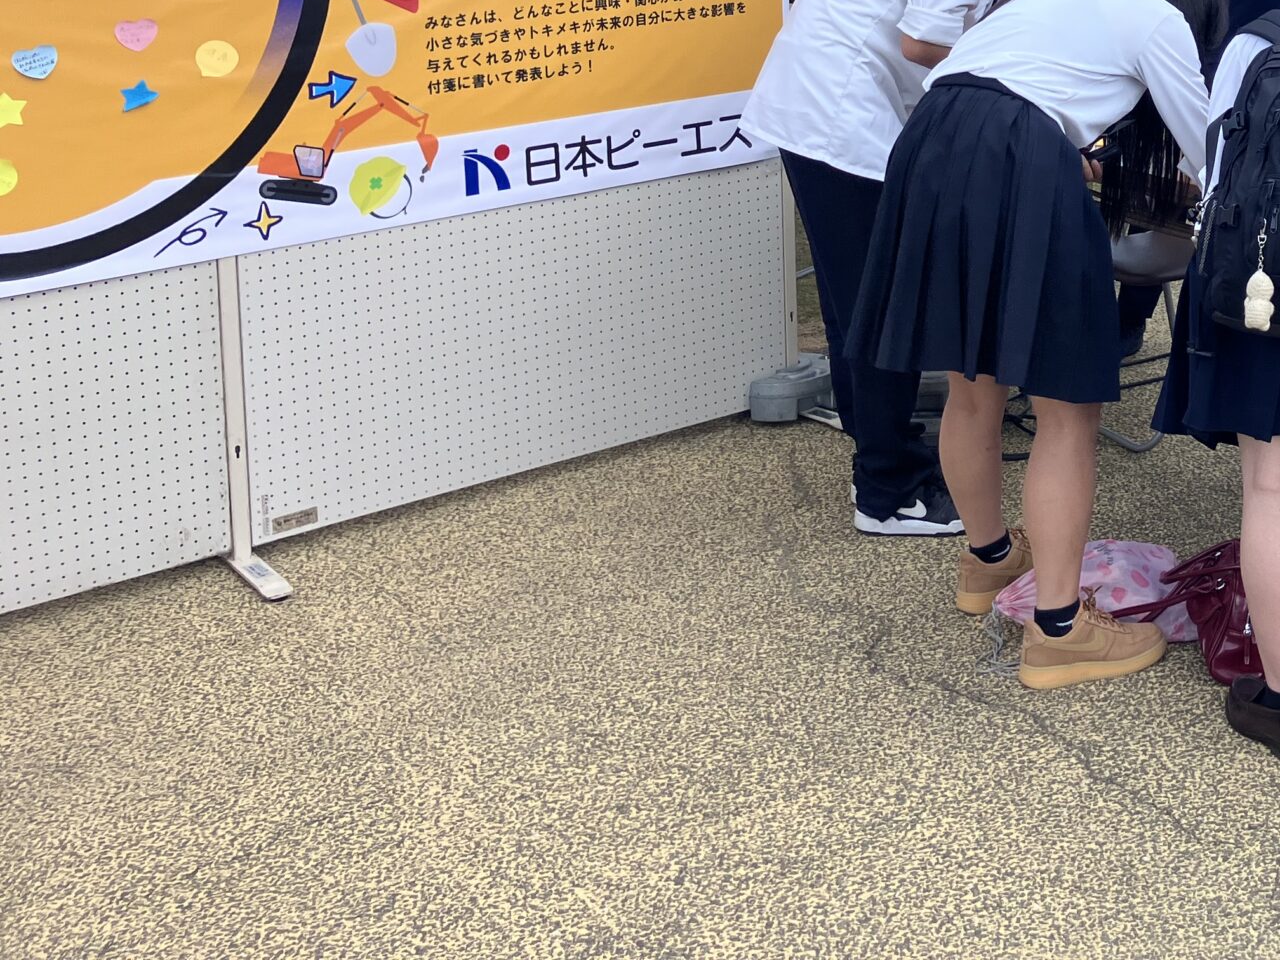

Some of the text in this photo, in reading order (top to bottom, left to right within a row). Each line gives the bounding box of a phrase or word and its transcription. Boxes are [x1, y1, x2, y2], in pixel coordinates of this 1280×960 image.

[425, 2, 747, 52] 小さな気づきやトキメキが未来の自分に大きな影響を
[426, 38, 616, 73] 与えてくれるかもしれません。
[427, 59, 594, 95] 付箋に書いて発表しよう！
